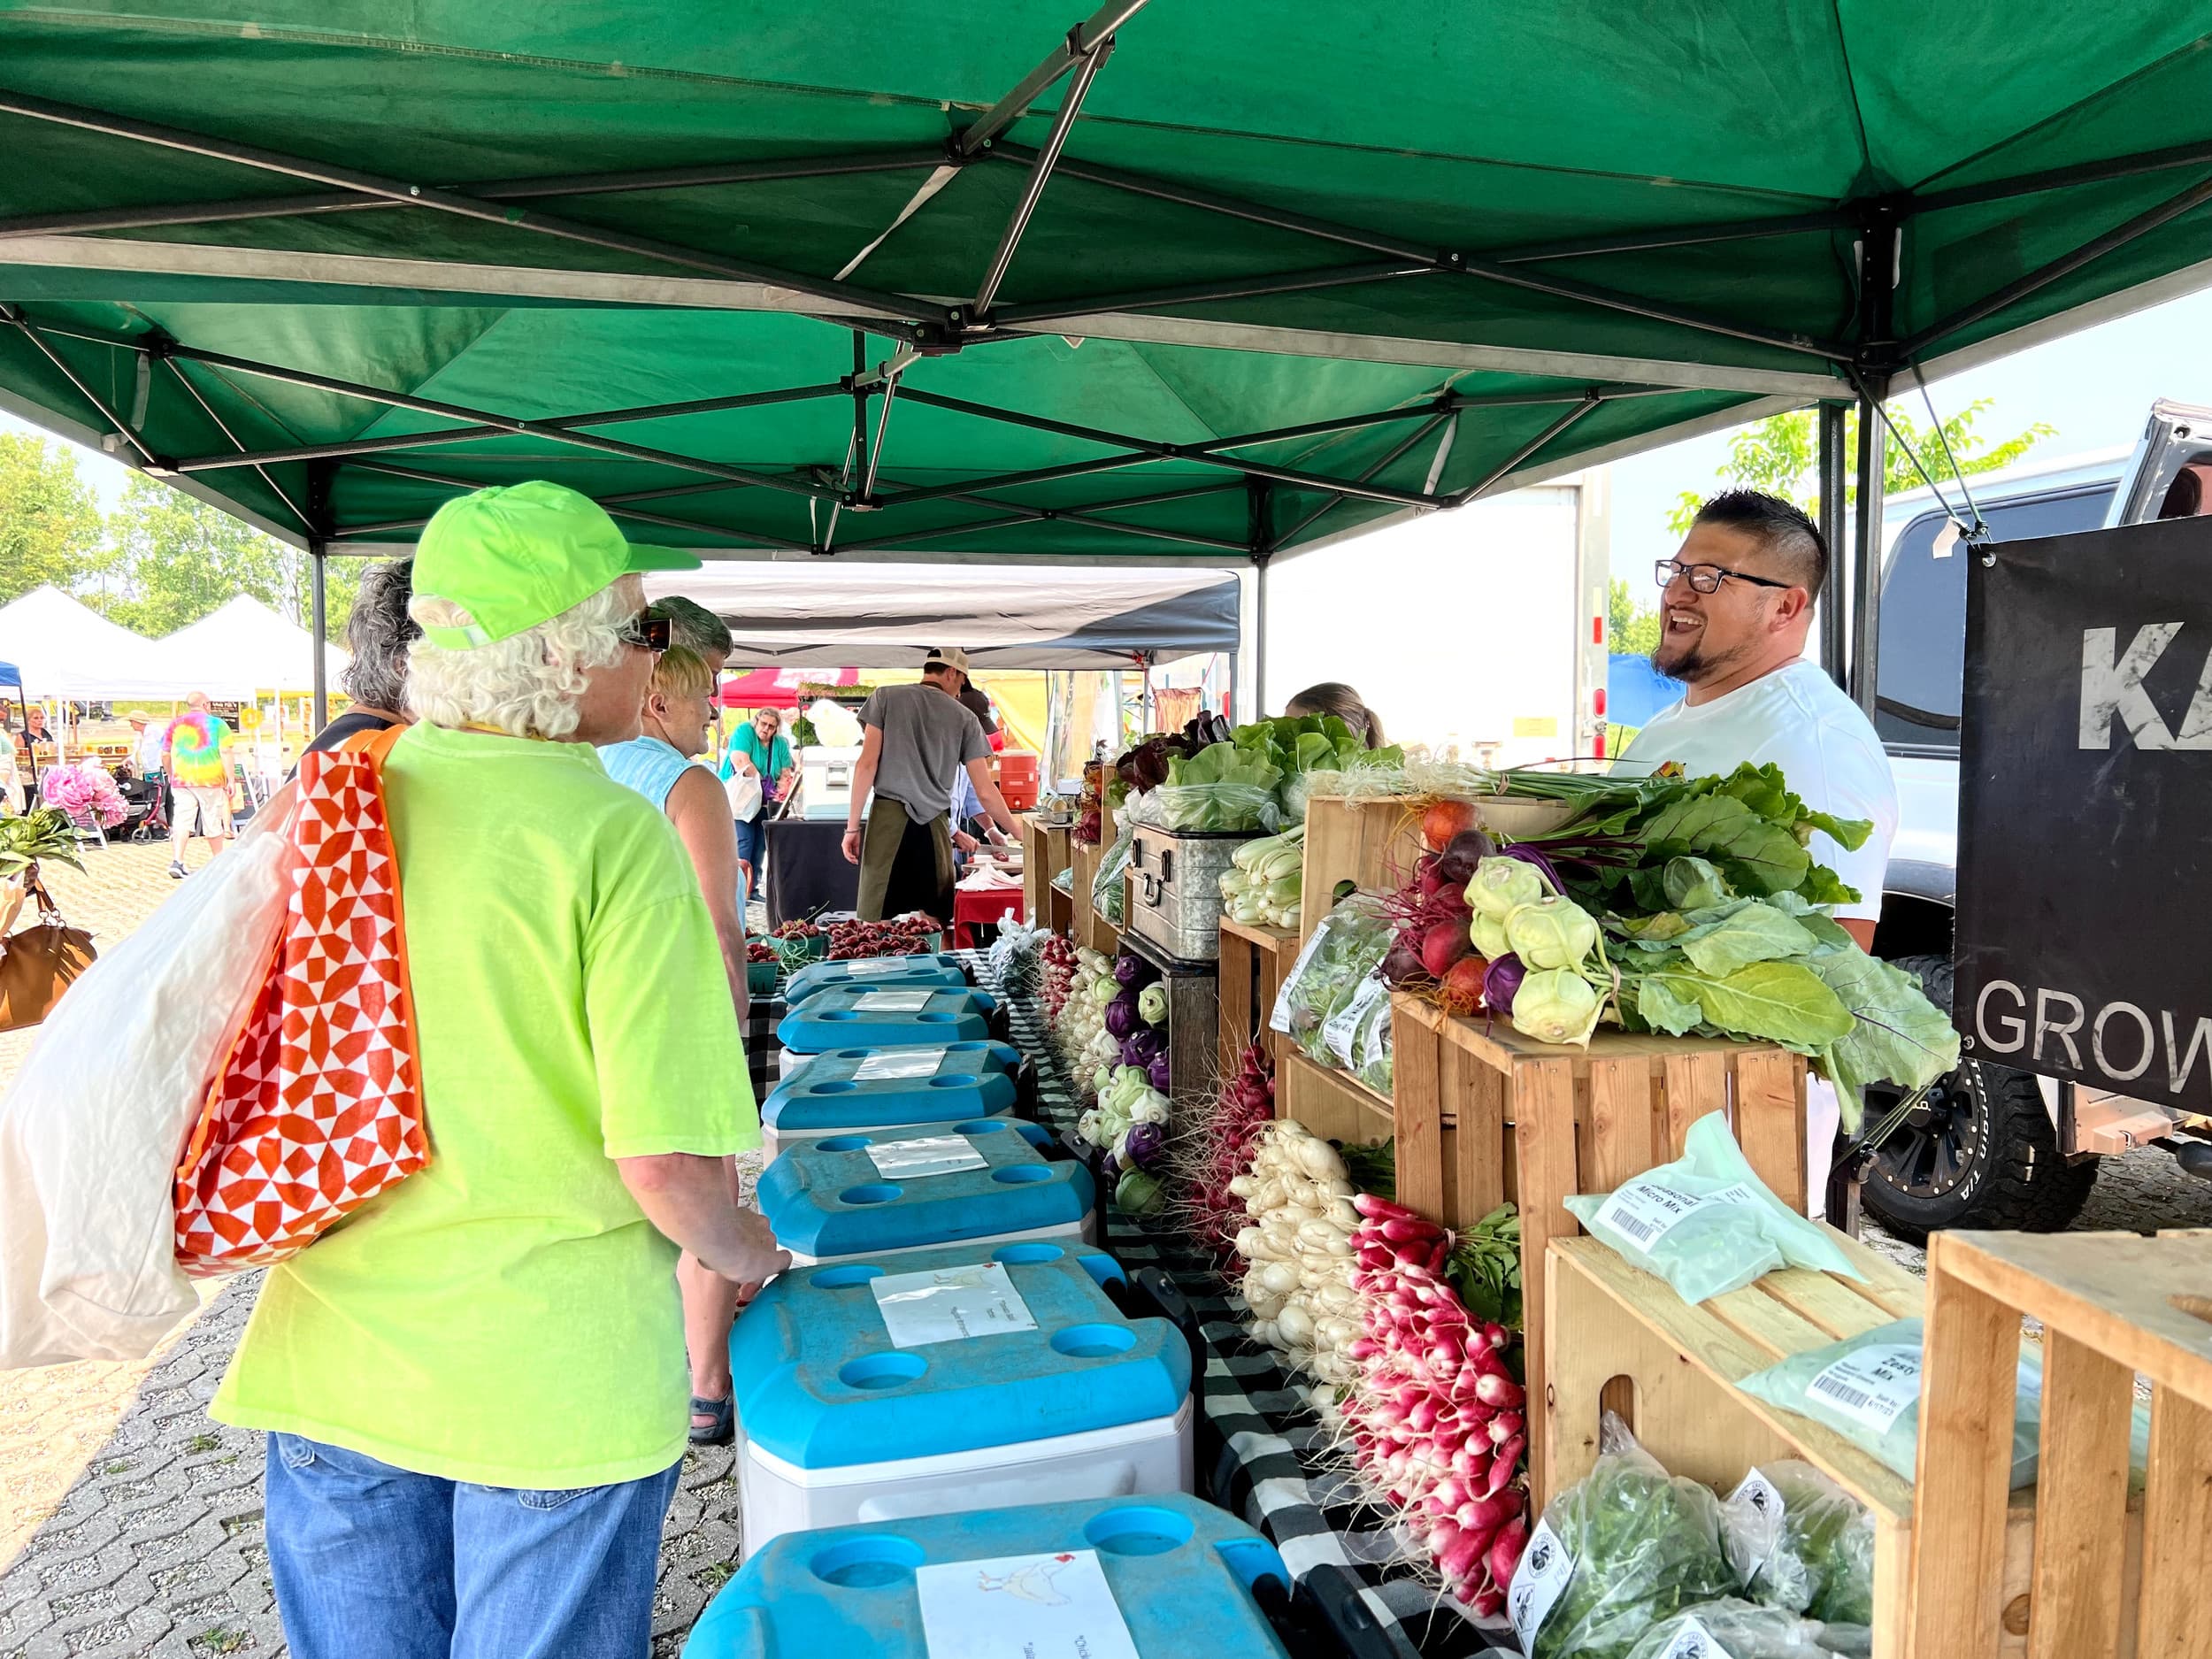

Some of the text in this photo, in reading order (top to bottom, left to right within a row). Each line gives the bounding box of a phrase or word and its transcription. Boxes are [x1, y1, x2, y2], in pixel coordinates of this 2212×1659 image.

[1961, 1059, 1989, 1201] Terrain T/A
[1637, 1185, 1664, 1203] Micro
[1663, 1199, 1684, 1215] Mix
